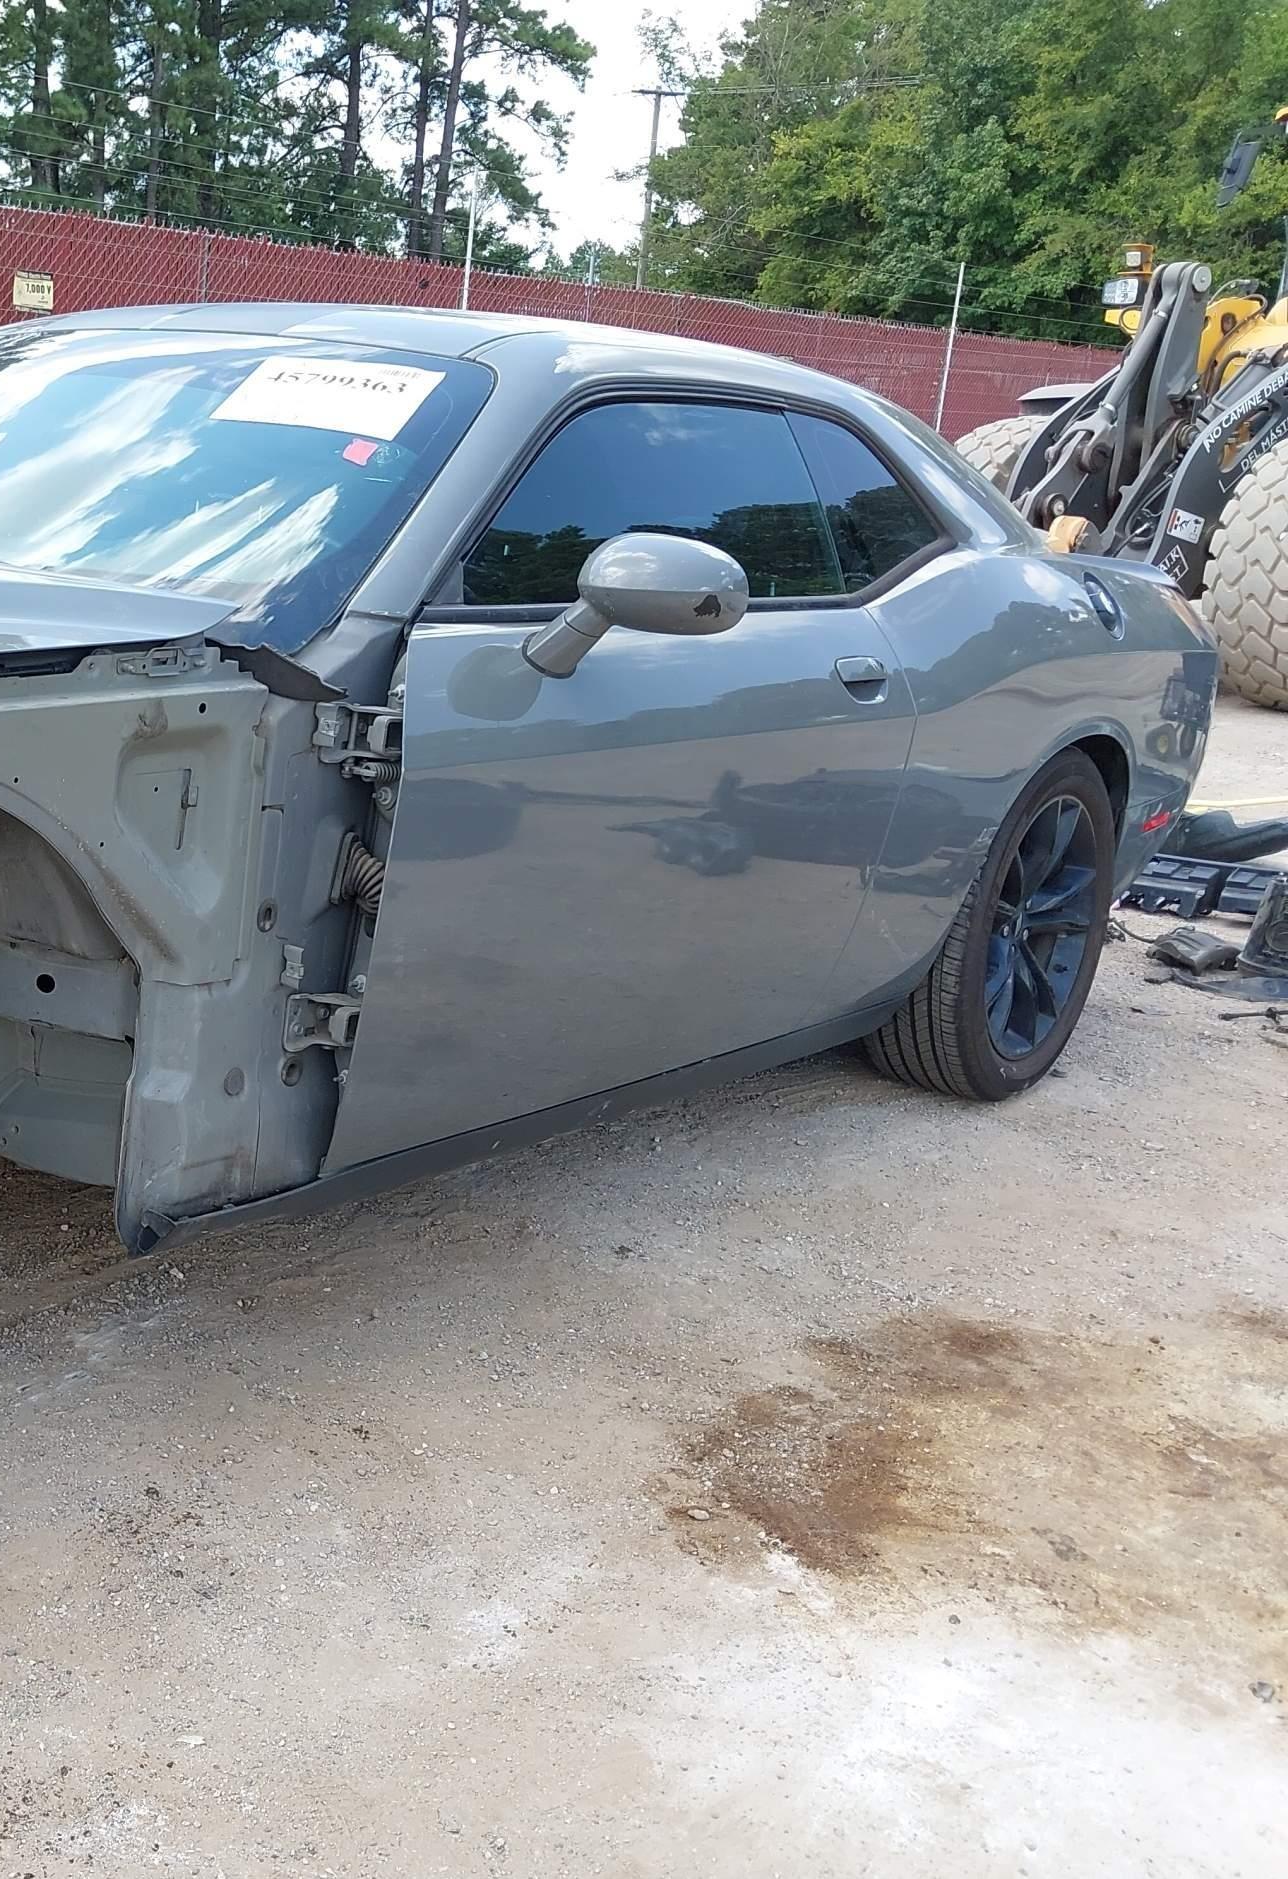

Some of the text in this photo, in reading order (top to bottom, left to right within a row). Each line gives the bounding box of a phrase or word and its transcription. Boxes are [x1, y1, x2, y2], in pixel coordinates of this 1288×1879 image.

[267, 371, 407, 393] 45799363
[1205, 427, 1222, 448] NO
[1222, 388, 1264, 428] CAMINE
[1241, 417, 1288, 472] DEL MÁST
